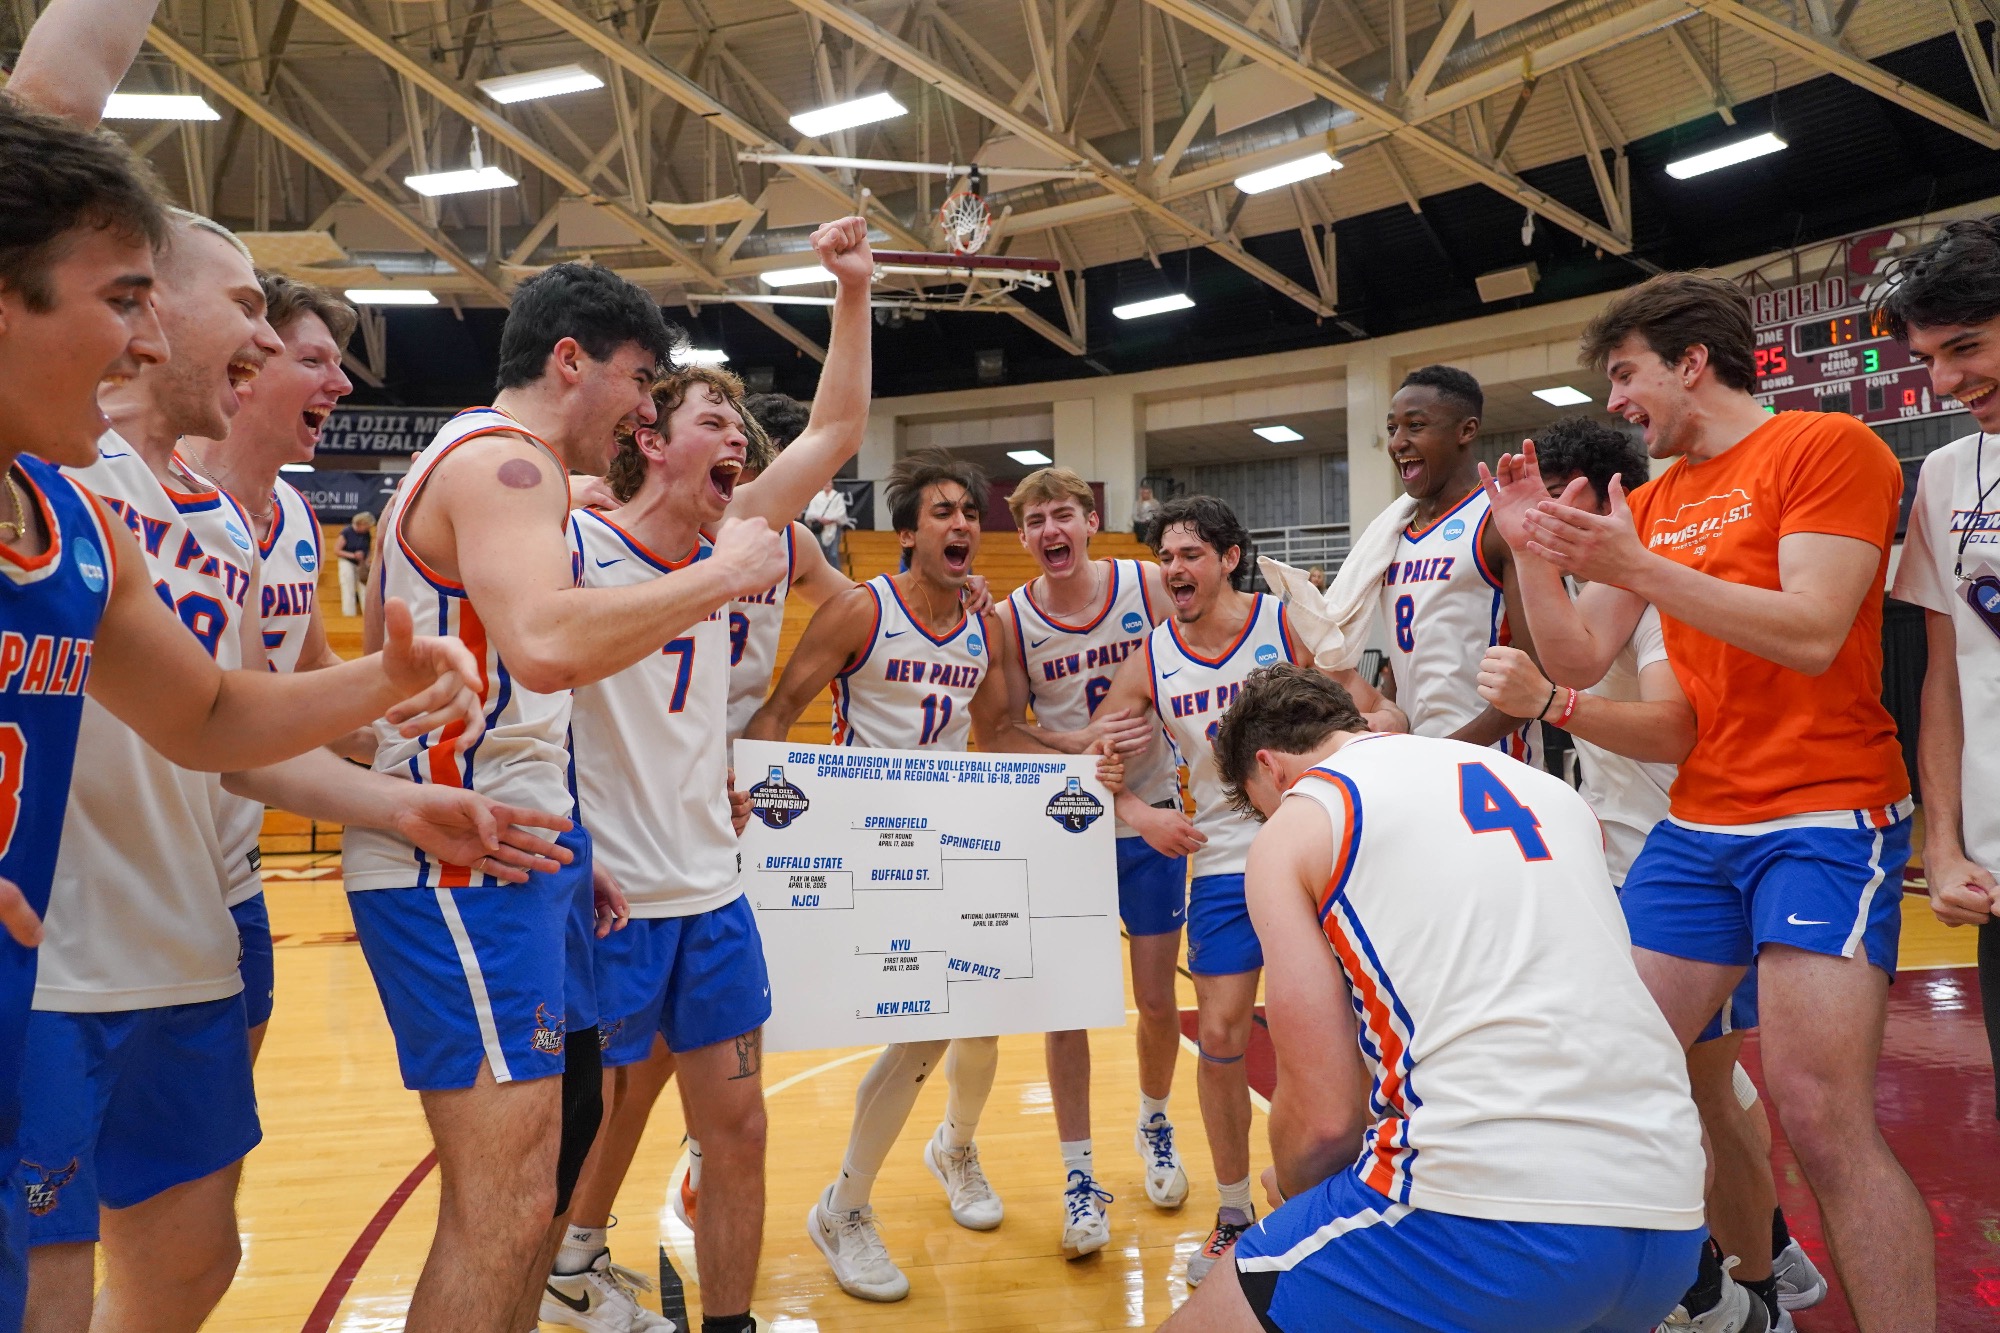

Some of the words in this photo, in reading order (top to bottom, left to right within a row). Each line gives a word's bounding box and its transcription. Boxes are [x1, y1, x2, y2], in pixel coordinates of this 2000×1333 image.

[1749, 276, 1846, 327] GFIELD
[1756, 330, 1784, 346] OME
[1821, 357, 1858, 372] PERIOD
[1863, 349, 1879, 373] 3
[1761, 375, 1794, 390] BONUS
[1865, 373, 1899, 388] FOULS
[1814, 381, 1852, 397] PLAYER
[1899, 405, 1920, 418] TOL
[322, 415, 353, 432] AA
[356, 416, 409, 433] DIII
[318, 433, 431, 450] LLEYBALL
[303, 490, 341, 504] SION
[1445, 528, 1463, 536] NCAA
[1968, 534, 1999, 544] OLL
[1402, 557, 1456, 584] PALTZ
[1125, 620, 1143, 629] NCAA
[1395, 594, 1415, 653] 8
[1258, 651, 1278, 663] NCAA
[662, 636, 695, 713] 7
[885, 659, 926, 683] NEW
[929, 663, 979, 689] PALTZ
[1042, 653, 1080, 681] NEW
[1170, 689, 1210, 718] NEW
[919, 693, 953, 746] 11
[788, 752, 815, 764] 2026
[818, 754, 844, 766] NCAA
[846, 755, 889, 768] DIVISION
[892, 758, 902, 768] III
[904, 759, 935, 770] MEN'S
[938, 760, 992, 772] VOLLEYBALL
[995, 762, 1066, 773] CHAMPIONSHIP
[817, 766, 883, 780] SPRINGFIELD,
[886, 770, 901, 780] MA
[904, 770, 950, 782] REGIONAL
[958, 771, 985, 783] APRIL
[987, 773, 1012, 784] 16-18,
[1015, 774, 1041, 784] 2026
[753, 799, 808, 809] AMPIONSHIP
[1047, 806, 1103, 815] CHAMPIONSHIP
[1457, 761, 1553, 862] 4
[864, 816, 928, 829] SPRINGFIELD
[940, 833, 1001, 851] SPRINGFIELD
[766, 856, 811, 869] BUFFALO
[813, 857, 842, 869] STATE
[871, 869, 913, 881] BUFFALO
[916, 869, 930, 881] ST.
[791, 895, 820, 907] NJCU
[891, 939, 911, 951] NYU
[948, 957, 971, 973] NEW
[972, 963, 1001, 979] PALTZ
[876, 1002, 899, 1015] NEW
[902, 1000, 931, 1013] PALTZ
[28, 1190, 56, 1203] LTZ
